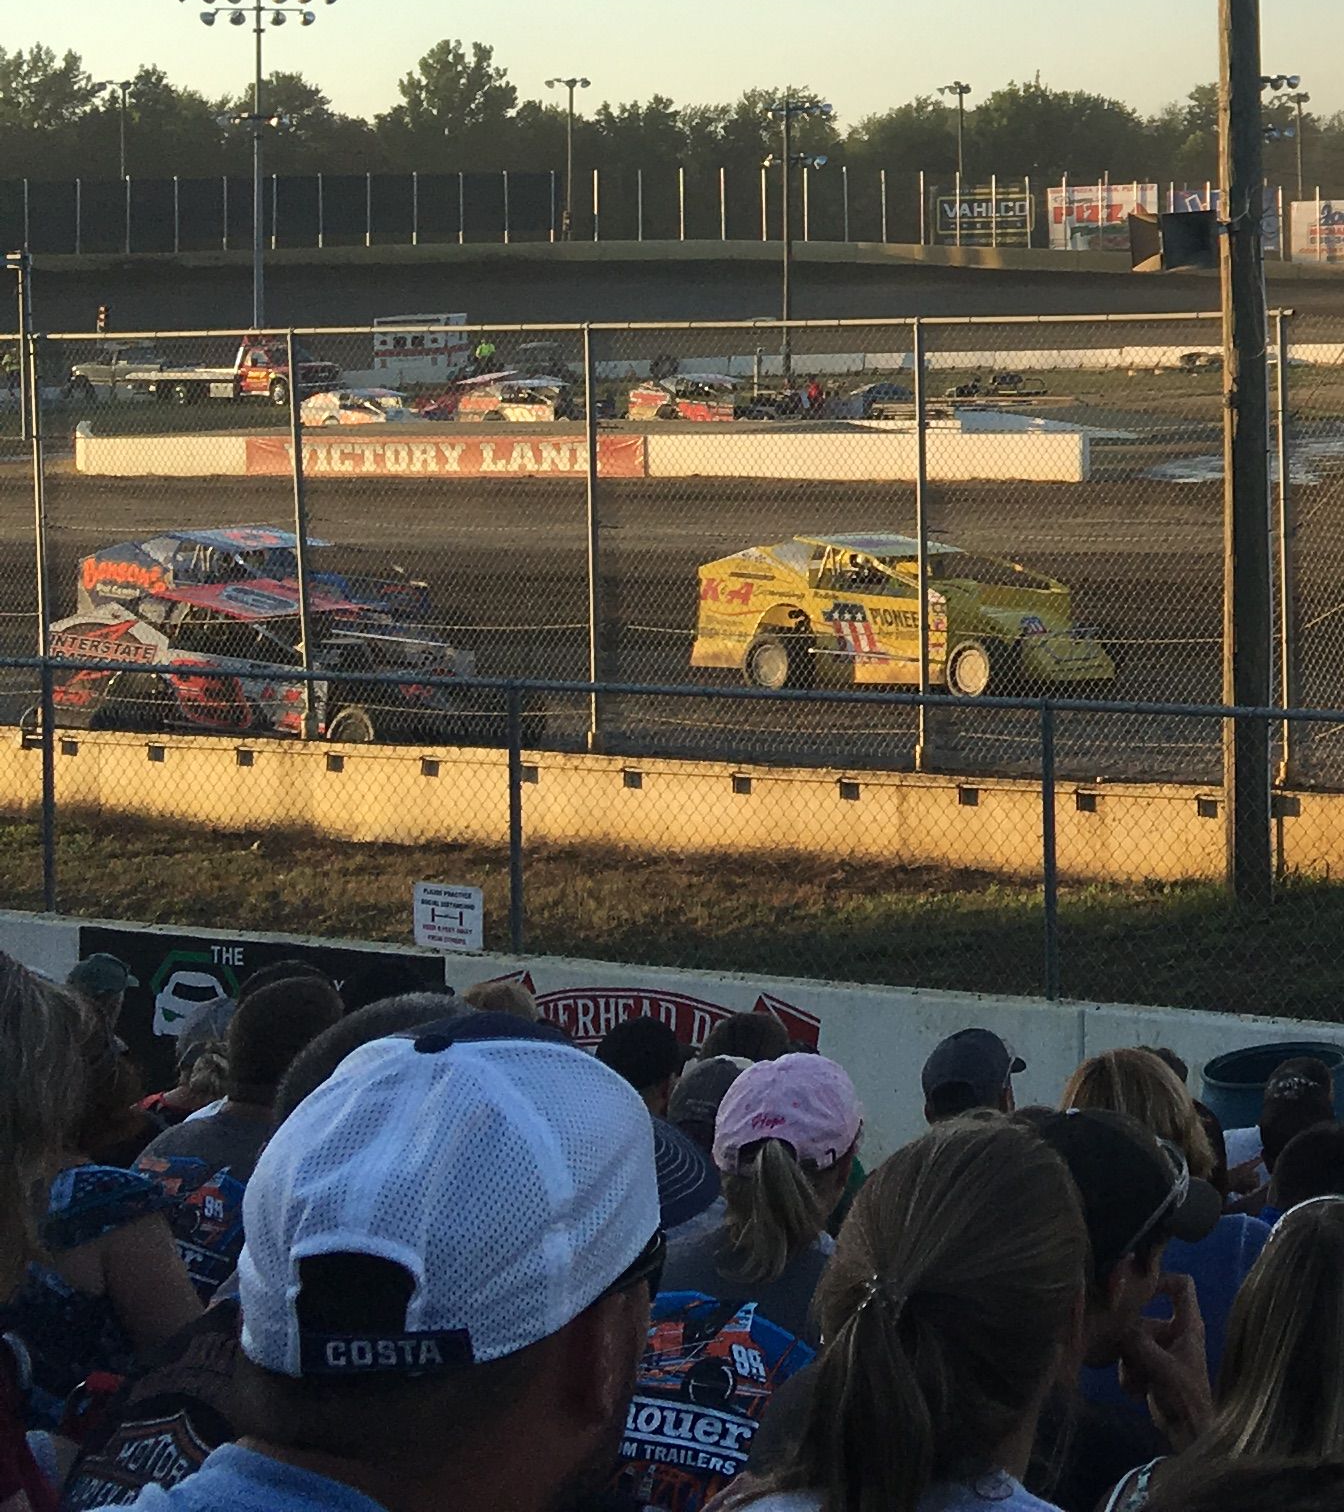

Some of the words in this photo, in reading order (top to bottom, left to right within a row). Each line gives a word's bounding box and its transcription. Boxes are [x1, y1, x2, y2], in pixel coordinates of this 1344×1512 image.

[285, 442, 465, 473] VICTORY
[211, 945, 245, 967] THE
[326, 1340, 443, 1366] COSTA
[644, 1442, 738, 1477] TRAILERS
